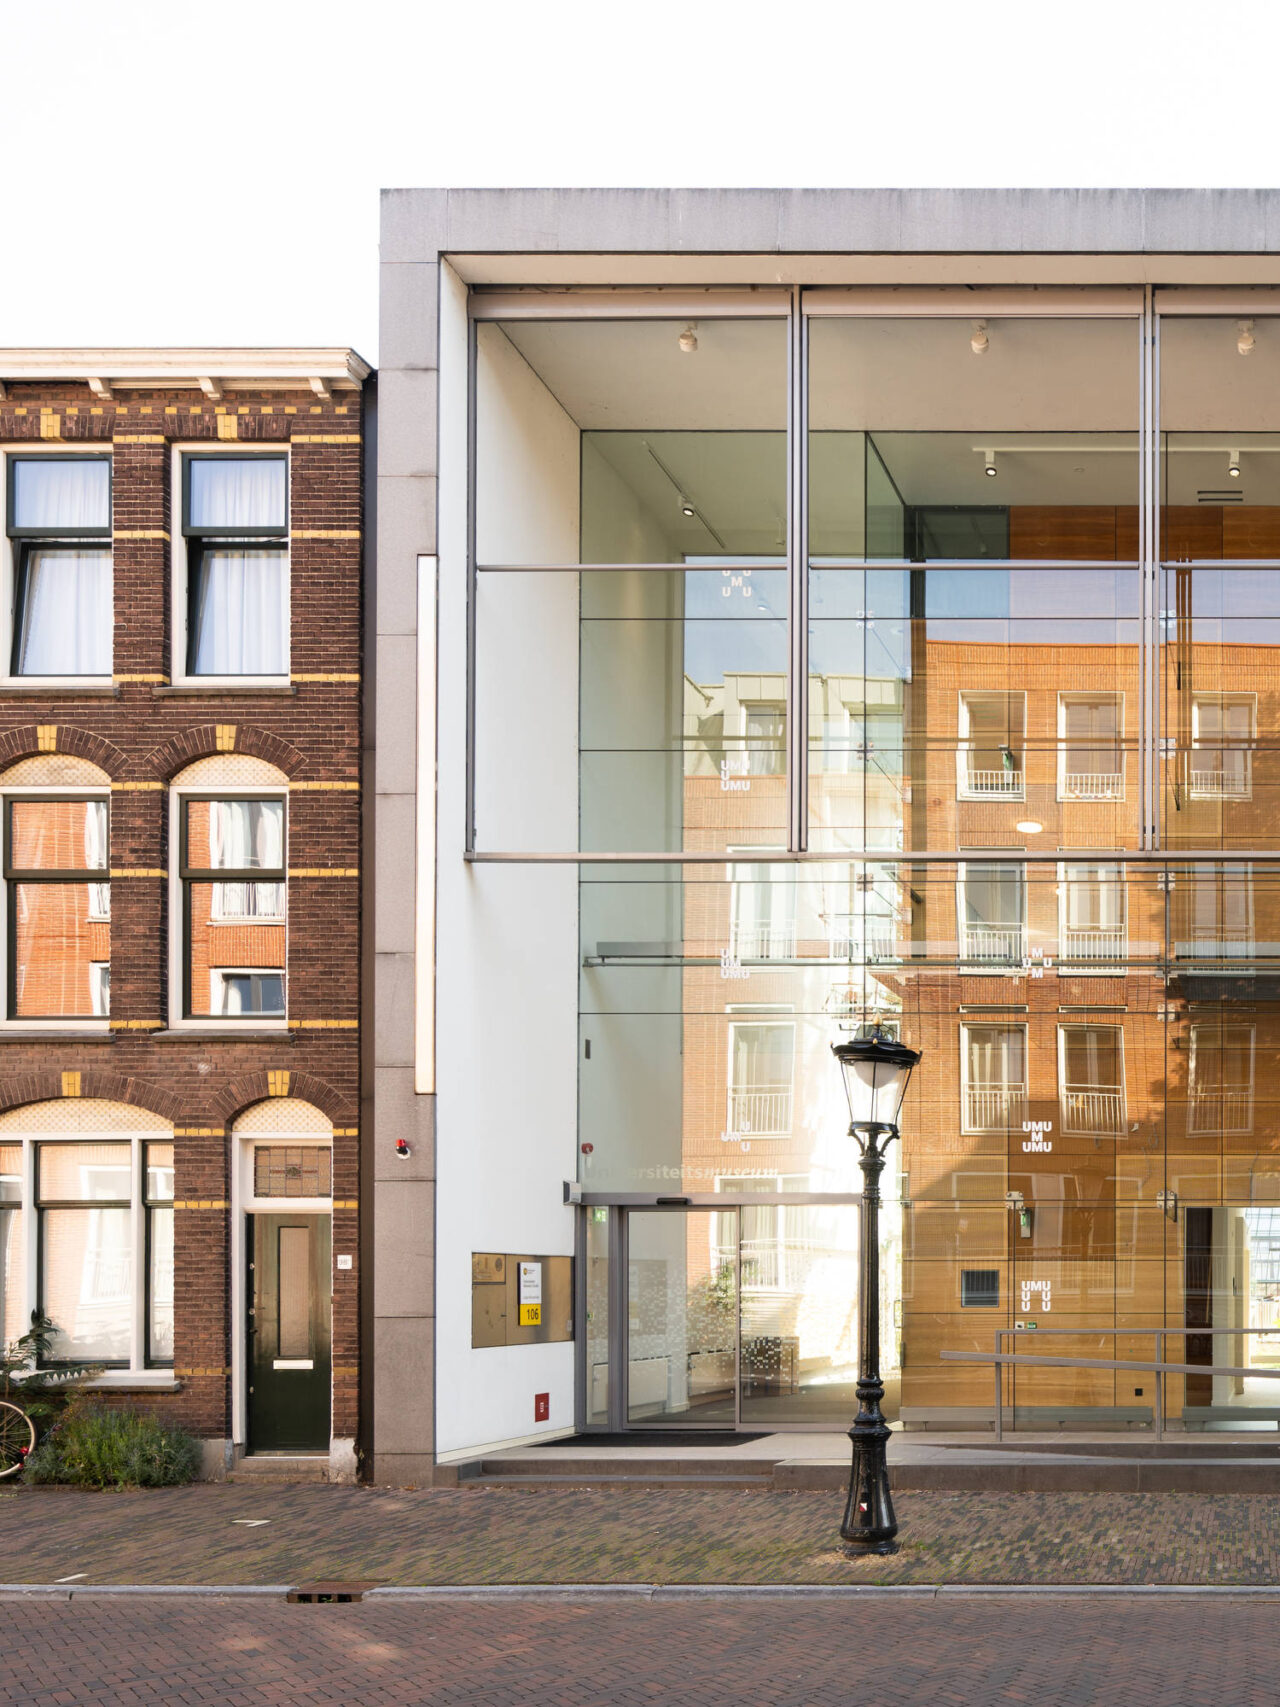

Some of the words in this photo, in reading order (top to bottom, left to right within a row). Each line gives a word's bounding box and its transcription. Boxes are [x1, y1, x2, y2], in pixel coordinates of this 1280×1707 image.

[721, 780, 750, 791] UMU
[721, 968, 750, 979] UMU
[1022, 1121, 1052, 1132] UMU
[1022, 1141, 1052, 1152] UMU
[1021, 1280, 1050, 1291] UMU
[526, 1308, 540, 1320] 106
